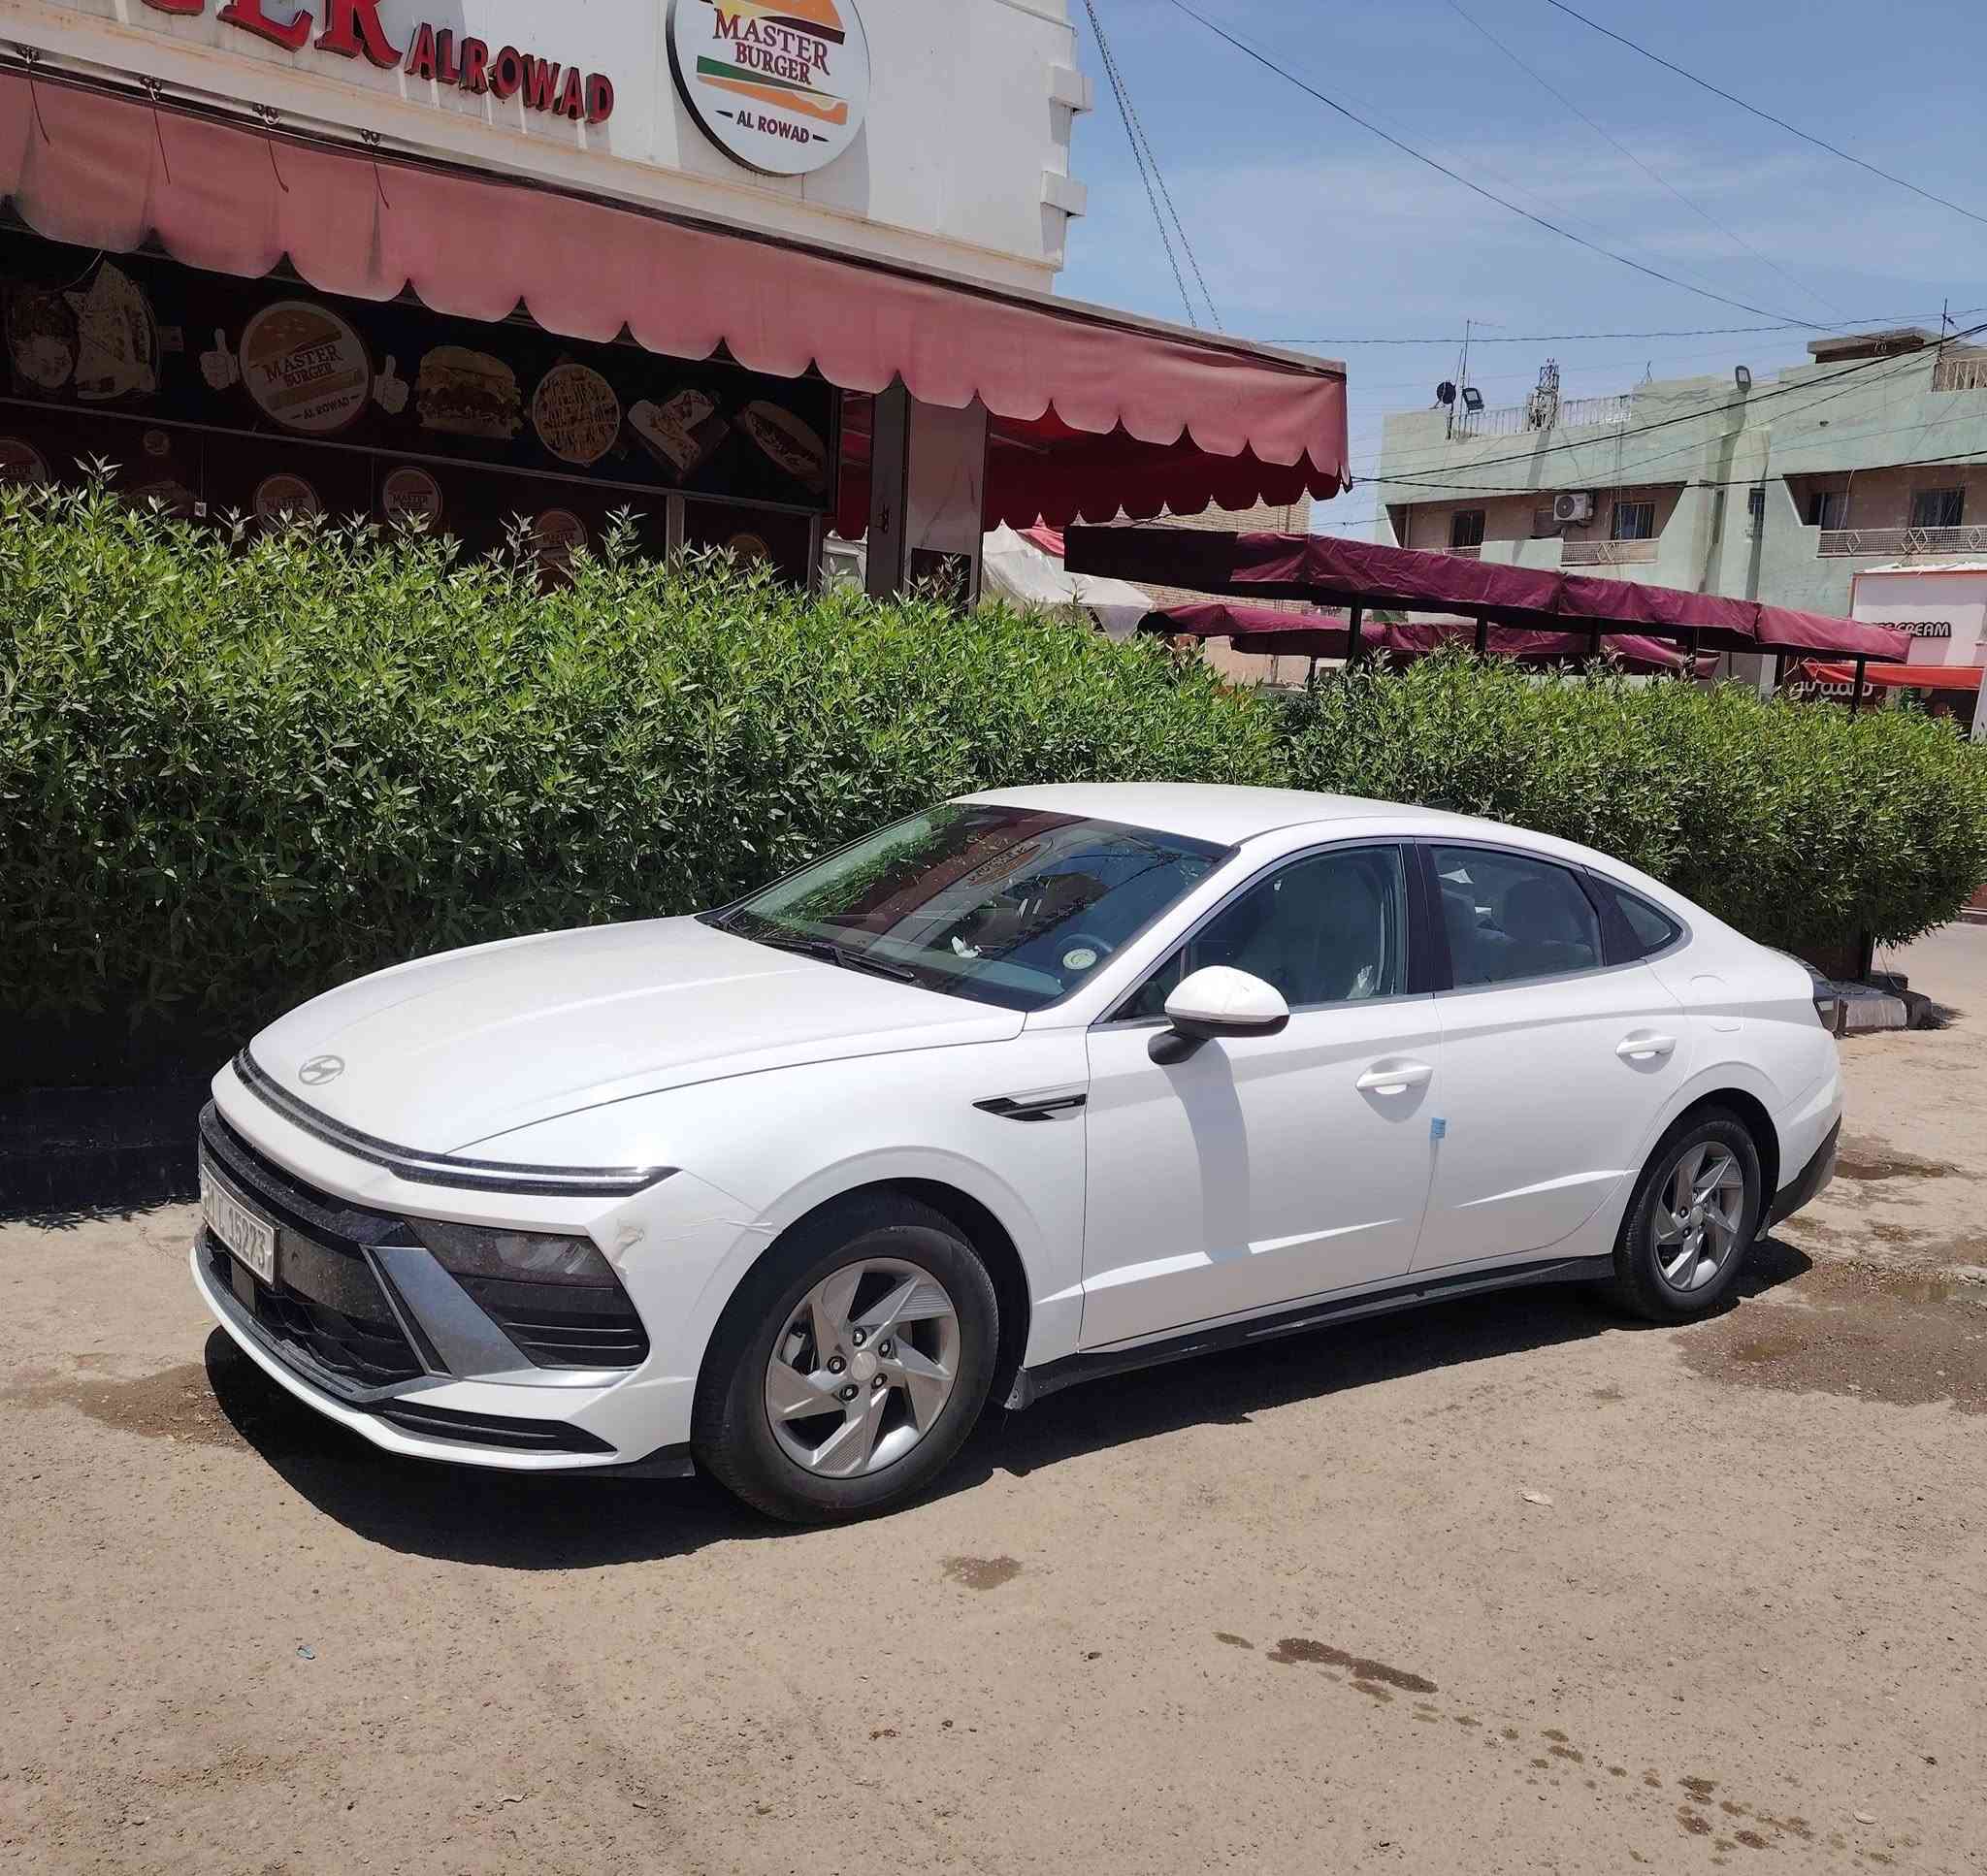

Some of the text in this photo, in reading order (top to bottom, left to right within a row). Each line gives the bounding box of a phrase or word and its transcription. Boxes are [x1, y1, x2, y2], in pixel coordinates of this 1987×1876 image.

[712, 8, 831, 76] MASTER
[734, 42, 812, 85] BURGER
[404, 22, 615, 124] ALROWAD
[736, 111, 810, 143] AL ROWAD
[264, 343, 343, 384] MASTER
